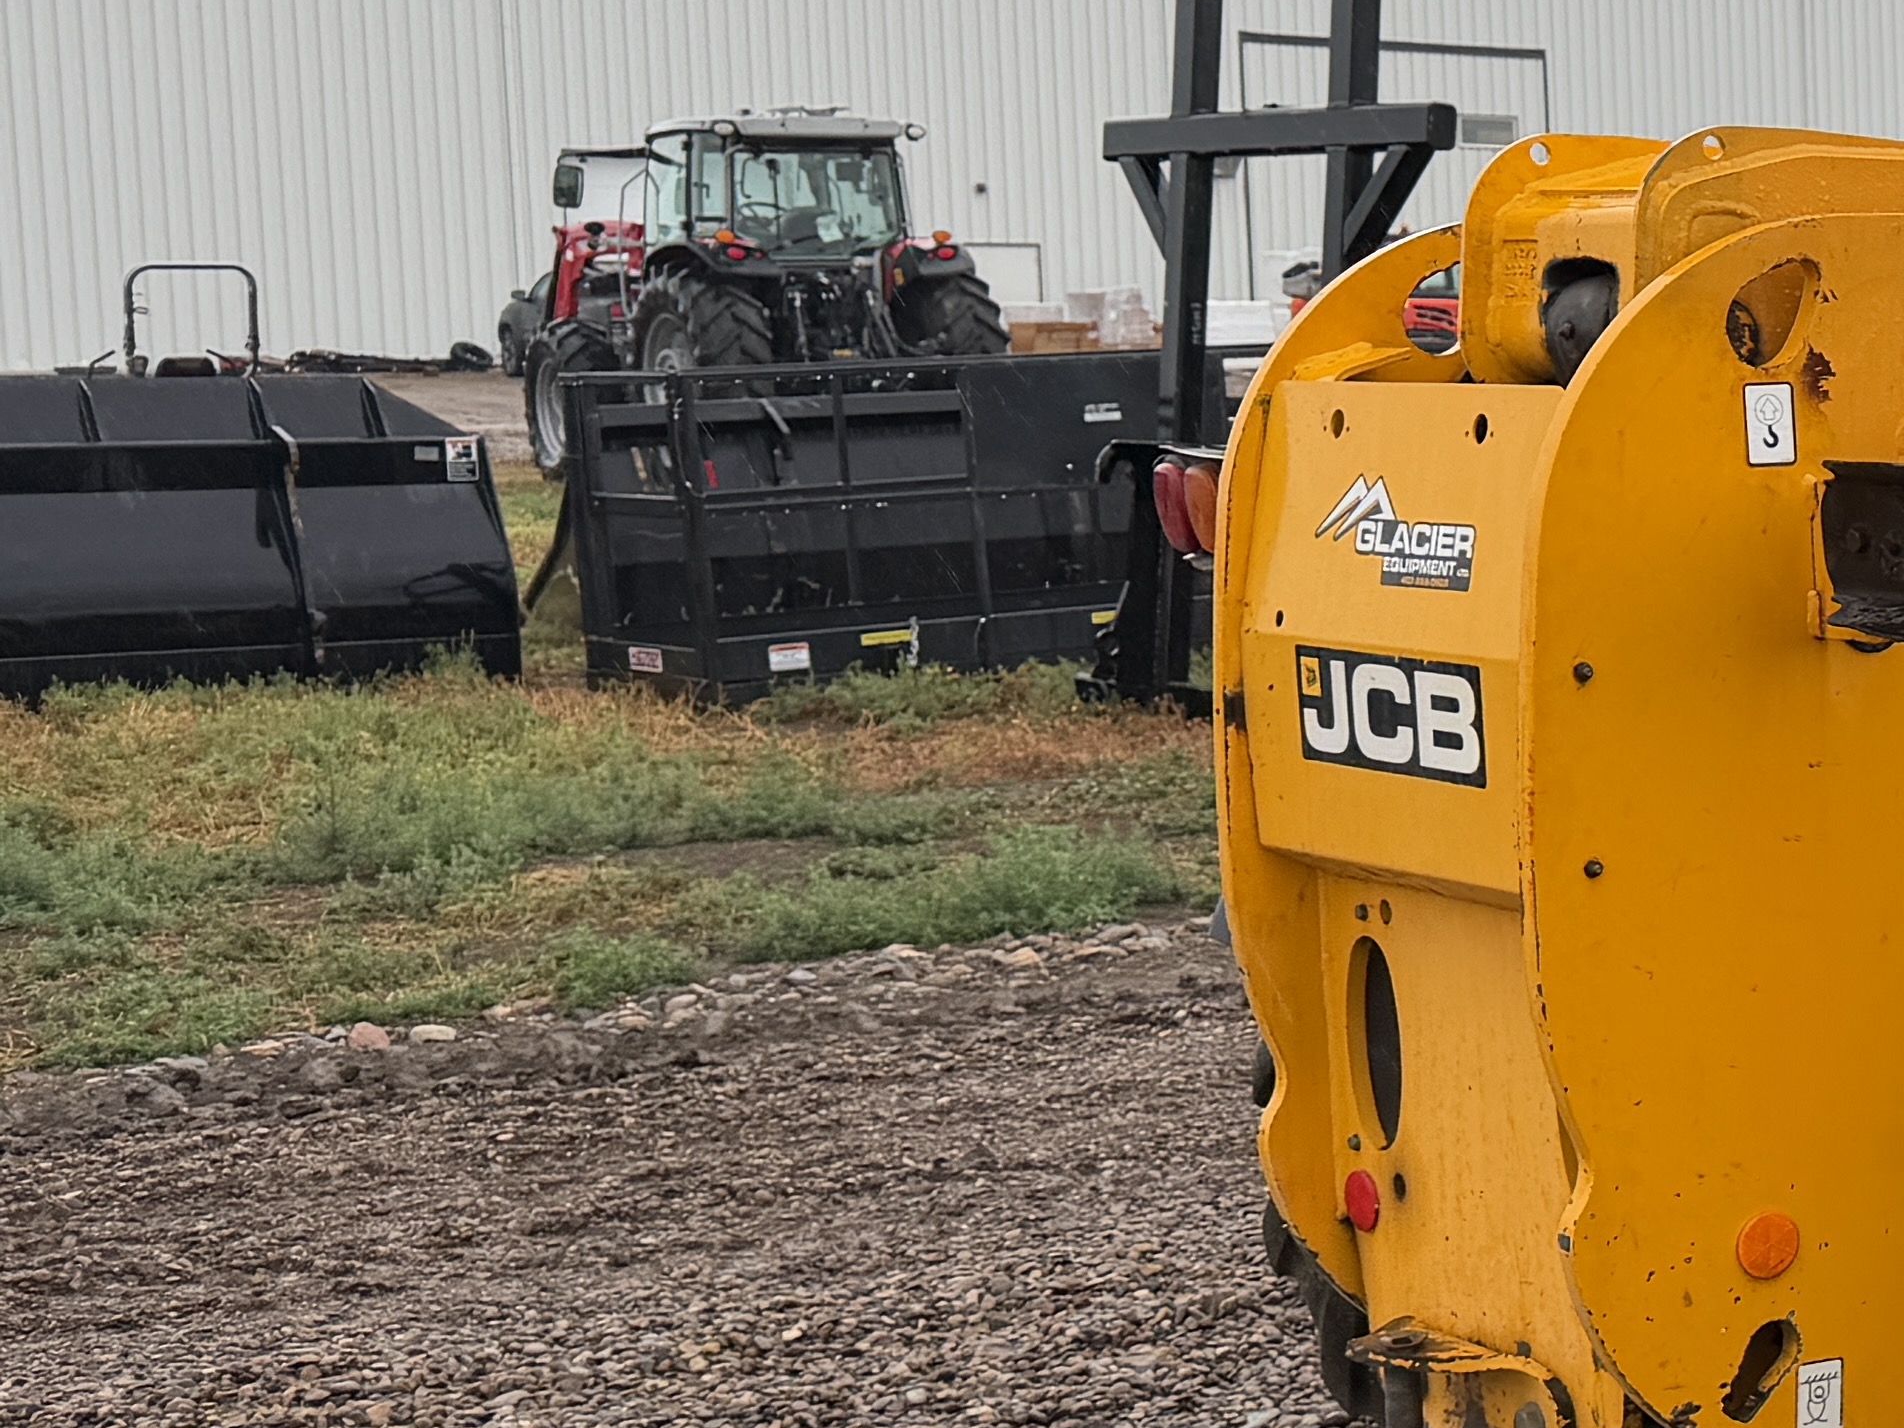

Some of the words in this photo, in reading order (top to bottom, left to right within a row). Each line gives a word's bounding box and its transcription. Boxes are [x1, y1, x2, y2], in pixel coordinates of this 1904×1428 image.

[1356, 520, 1475, 559] GLACIER
[1382, 556, 1457, 577] EQUIPMENT
[1303, 659, 1480, 775] JCB
